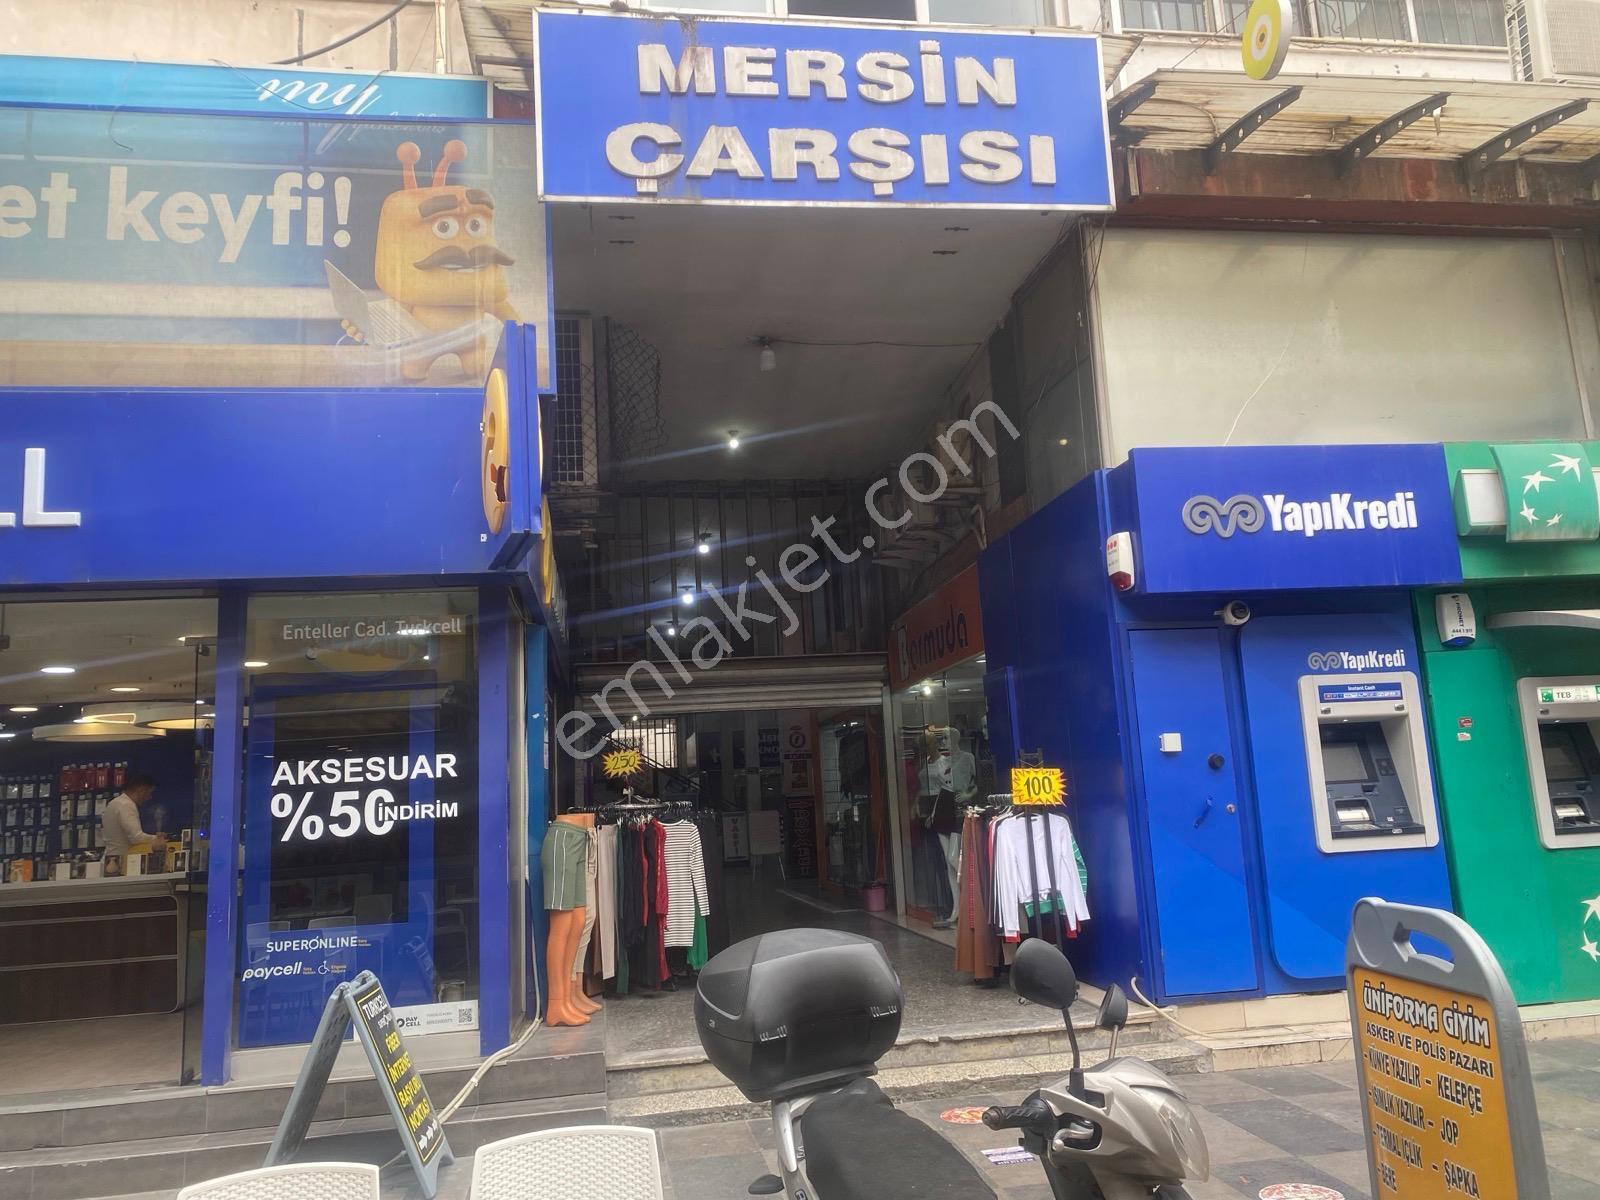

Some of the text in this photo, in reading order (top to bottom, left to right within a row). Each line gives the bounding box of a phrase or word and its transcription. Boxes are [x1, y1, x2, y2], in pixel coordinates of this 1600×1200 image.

[637, 40, 1017, 106] MERSİN
[605, 121, 1056, 196] ÇARŞISI
[106, 165, 352, 263] keyfi!
[282, 623, 350, 640] Enteller
[354, 622, 391, 638] Cad.
[1556, 691, 1572, 699] TEB
[271, 753, 459, 787] AKSESUAR
[612, 754, 636, 771] 250
[1023, 776, 1053, 798] 100
[270, 788, 459, 842] %50 İNDİRİM
[242, 961, 303, 982] paycell
[1363, 980, 1491, 1049] ÜNİFORMA GİYİM
[1366, 1022, 1494, 1078] ASKER VE POLİS PAZARI
[1390, 1055, 1421, 1088] YAZILIR
[1437, 1073, 1483, 1116] KELEPÇE
[1395, 1096, 1426, 1131] YAZILIR
[1440, 1117, 1459, 1147] JOP
[1443, 1159, 1480, 1199] ŞAPKA
